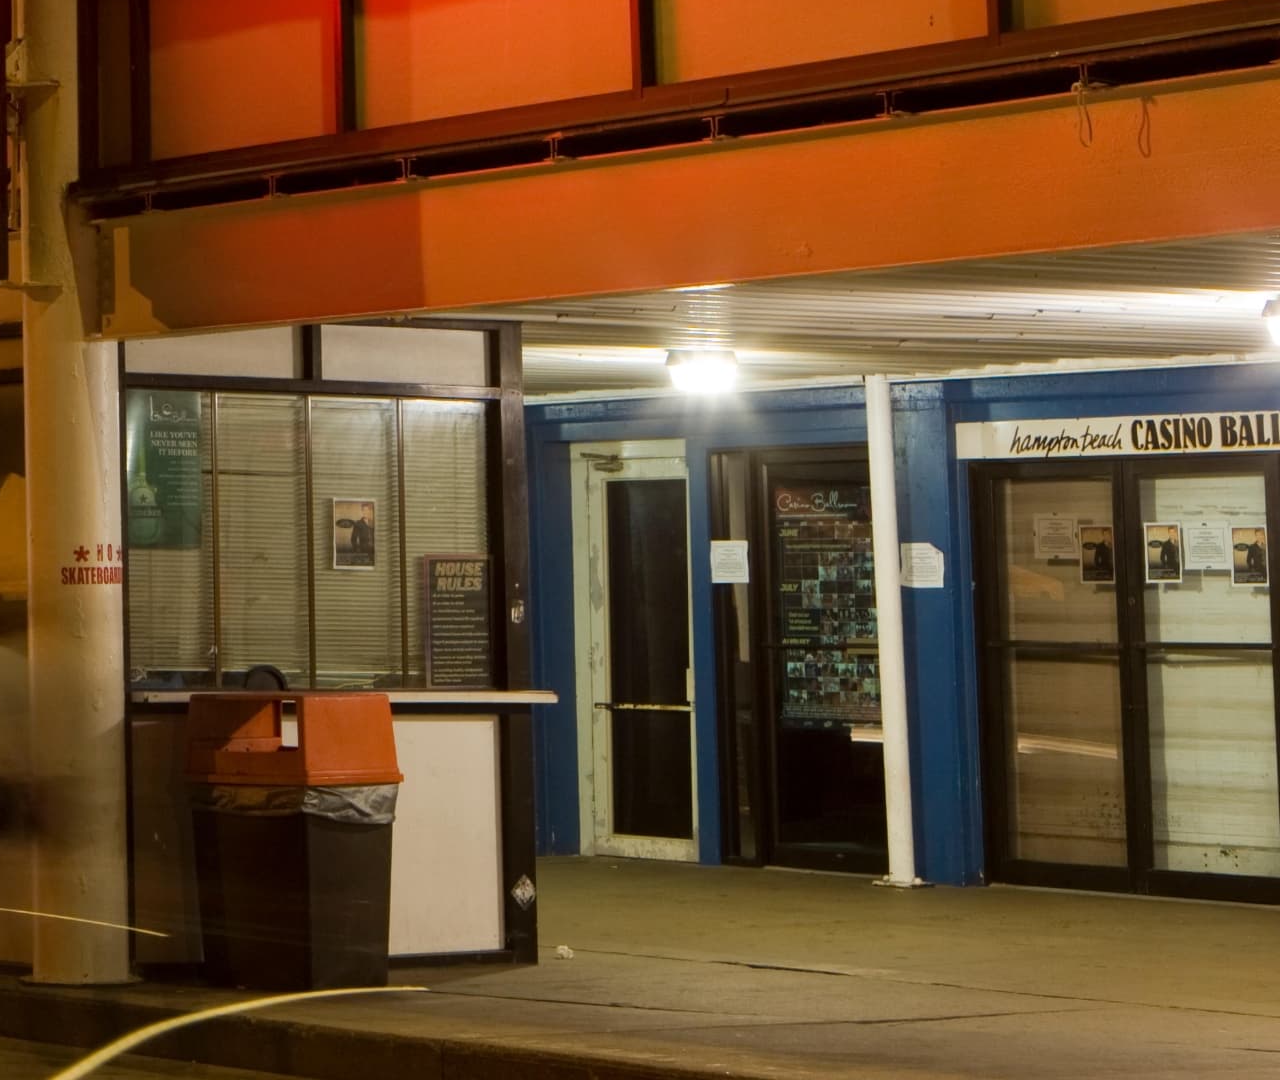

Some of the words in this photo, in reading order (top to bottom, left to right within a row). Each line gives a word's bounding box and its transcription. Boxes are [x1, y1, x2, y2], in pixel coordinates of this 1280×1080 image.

[150, 431, 169, 440] LIKE
[1009, 424, 1080, 457] hampton
[1080, 423, 1124, 452] beach
[1131, 416, 1214, 451] CASINO
[151, 440, 177, 448] NEVER
[178, 440, 198, 448] SEEN
[168, 448, 198, 457] BEFORE
[435, 561, 484, 576] HOUSE
[437, 577, 483, 591] RULES
